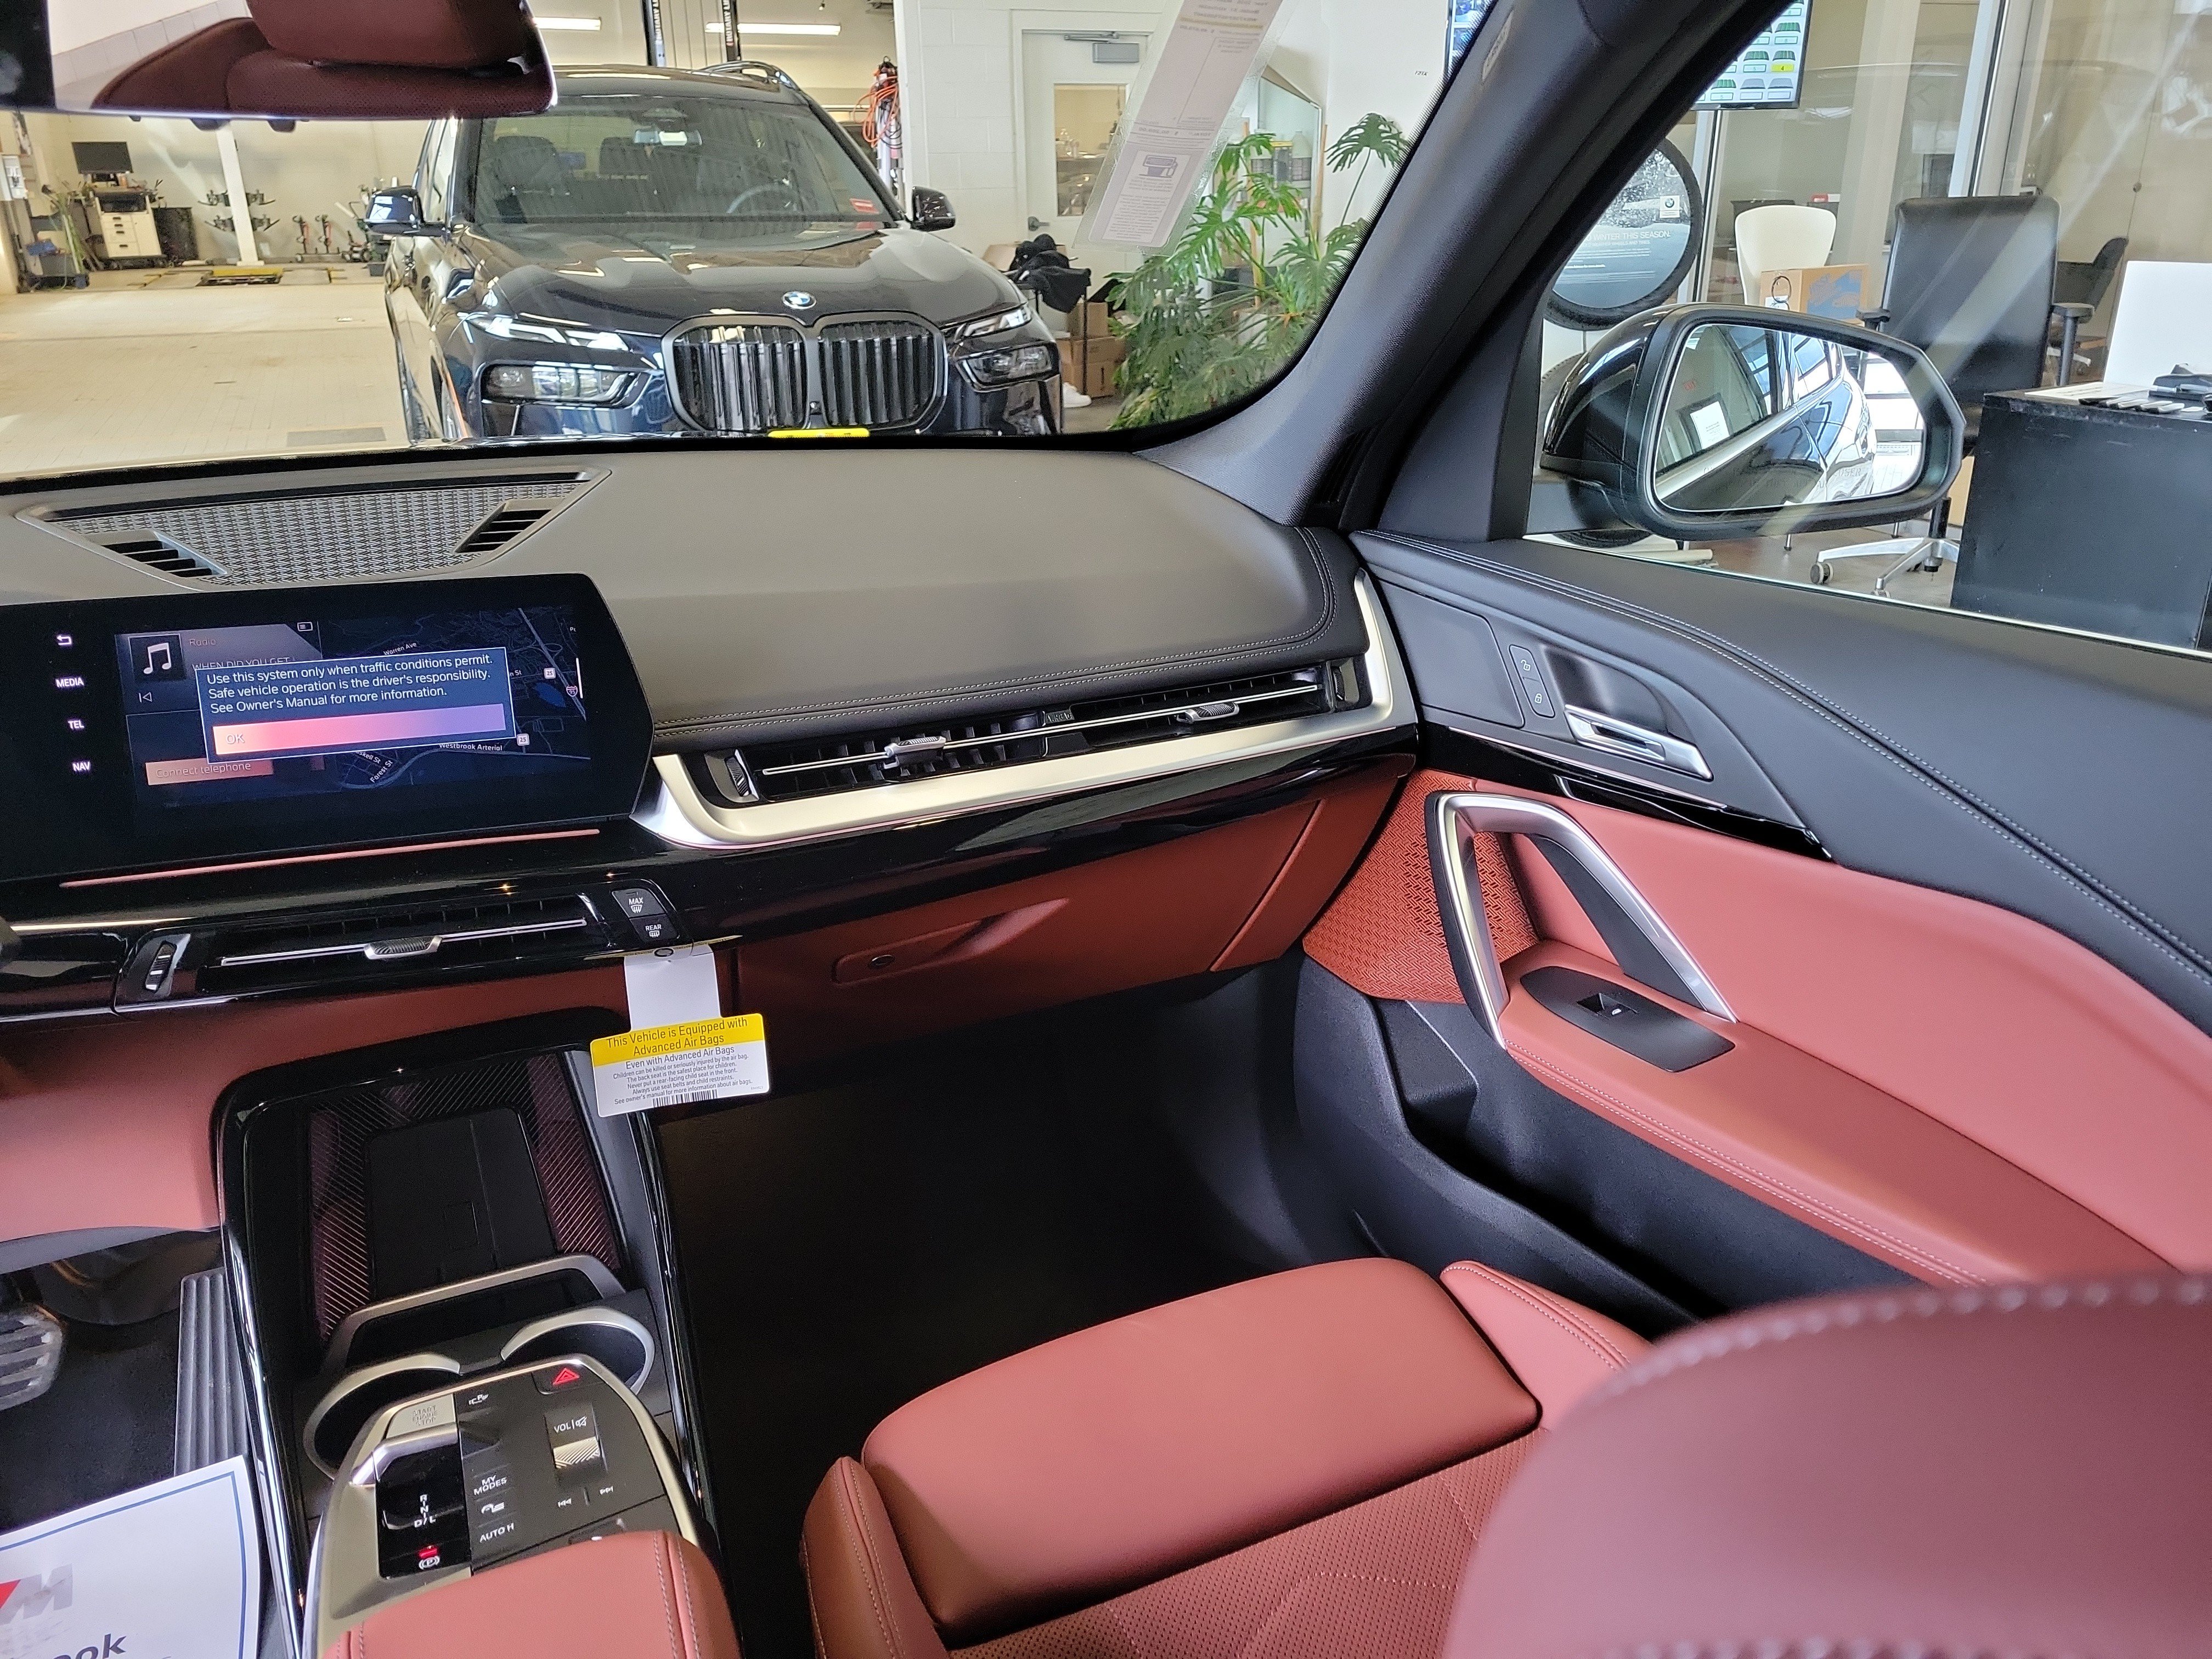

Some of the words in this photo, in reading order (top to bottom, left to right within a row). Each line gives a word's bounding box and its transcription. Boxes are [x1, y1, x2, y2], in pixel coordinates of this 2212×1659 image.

[1640, 230, 1671, 239] SEASON.
[384, 646, 404, 656] Warren
[207, 674, 230, 684] Use
[233, 672, 255, 682] this
[257, 669, 298, 682] system
[301, 667, 325, 678] only
[327, 665, 358, 675] when
[360, 662, 392, 673] traffic
[395, 658, 452, 670] conditions
[455, 654, 493, 668] permit.
[56, 677, 84, 688] MEDIA
[208, 688, 234, 699] Safe
[237, 685, 279, 696] vehicle
[281, 680, 336, 695] operation
[339, 679, 348, 689] is
[351, 678, 369, 688] the
[373, 675, 413, 686] driver's
[415, 669, 490, 684] responsibility.
[211, 703, 233, 714] See
[236, 699, 284, 712] Owner's
[286, 695, 328, 708] Manual
[330, 694, 346, 704] for
[349, 693, 378, 703] more
[381, 687, 447, 700] information.
[68, 719, 84, 730] TEL
[225, 733, 245, 744] OK
[72, 761, 91, 772] NAV
[156, 766, 198, 778] Connect
[201, 763, 251, 774] telephone
[370, 766, 388, 783] Forest
[629, 897, 644, 905] MAX
[606, 1036, 628, 1048] This
[629, 1029, 665, 1043] Vehicle
[668, 1028, 676, 1037] is
[679, 1020, 725, 1036] Equipped
[727, 1017, 747, 1029] with
[633, 1039, 681, 1057] Advanced
[684, 1037, 697, 1048] Air
[700, 1035, 724, 1046] Bags
[626, 1061, 645, 1069] Even
[646, 1057, 662, 1065] with
[664, 1049, 702, 1063] Advanced
[703, 1048, 713, 1057] Air
[715, 1047, 735, 1055] Bags
[625, 1094, 646, 1102] owner's
[687, 1084, 716, 1092] information
[554, 1422, 572, 1434] VOL
[473, 1477, 507, 1496] MODES
[482, 1475, 496, 1486] MY
[420, 1505, 428, 1514] N
[479, 1527, 505, 1543] AUTO
[506, 1522, 514, 1533] H
